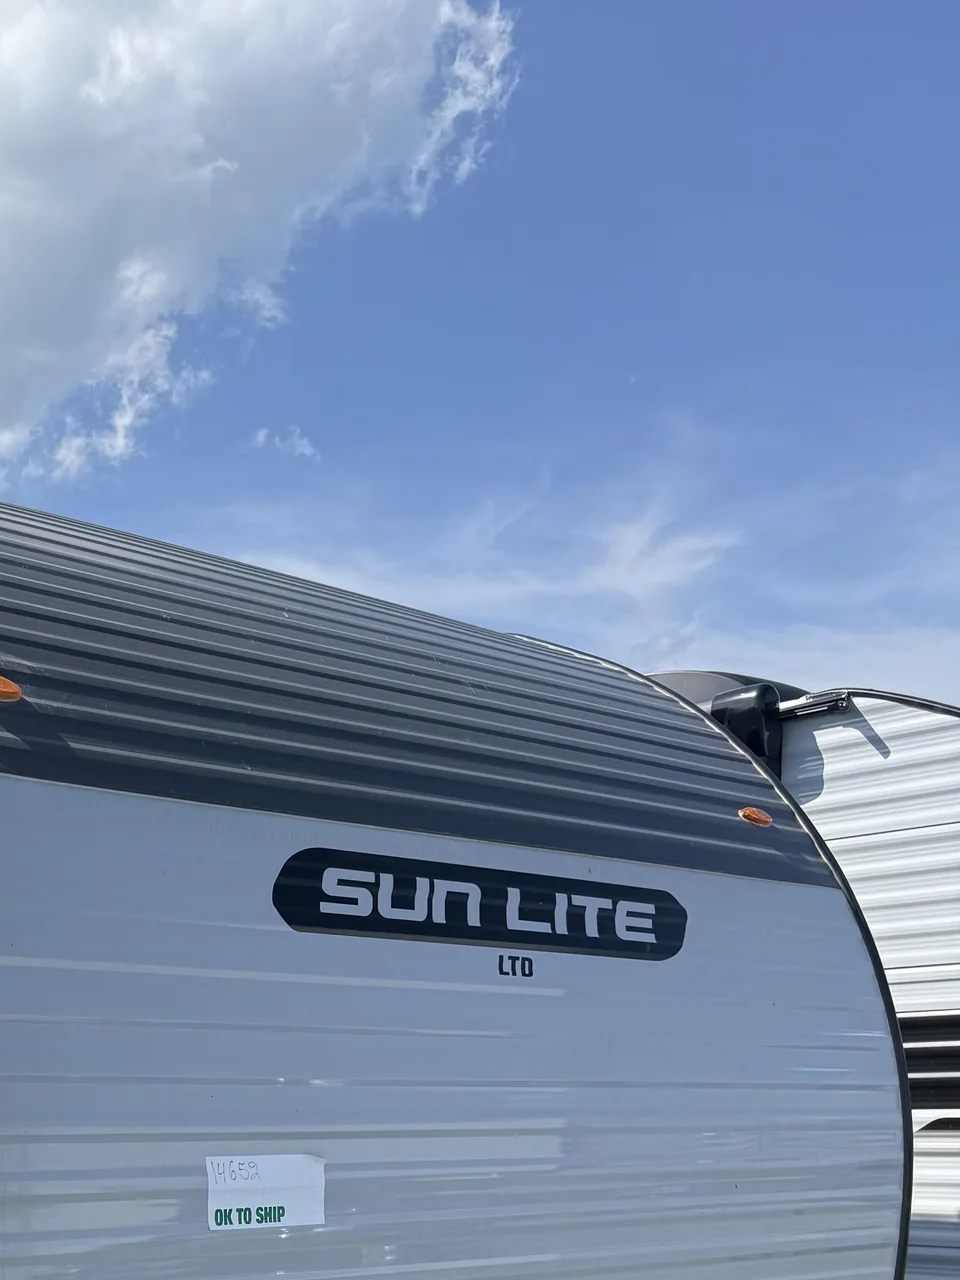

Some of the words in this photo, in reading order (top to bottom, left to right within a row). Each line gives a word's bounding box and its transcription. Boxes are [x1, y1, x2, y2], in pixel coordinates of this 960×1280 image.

[319, 867, 481, 927] SUN
[506, 887, 658, 944] LITE
[498, 954, 534, 978] LTD
[210, 1160, 262, 1186] 14652
[214, 1208, 234, 1226] OK
[236, 1207, 252, 1225] TO
[255, 1205, 286, 1223] SHIP
